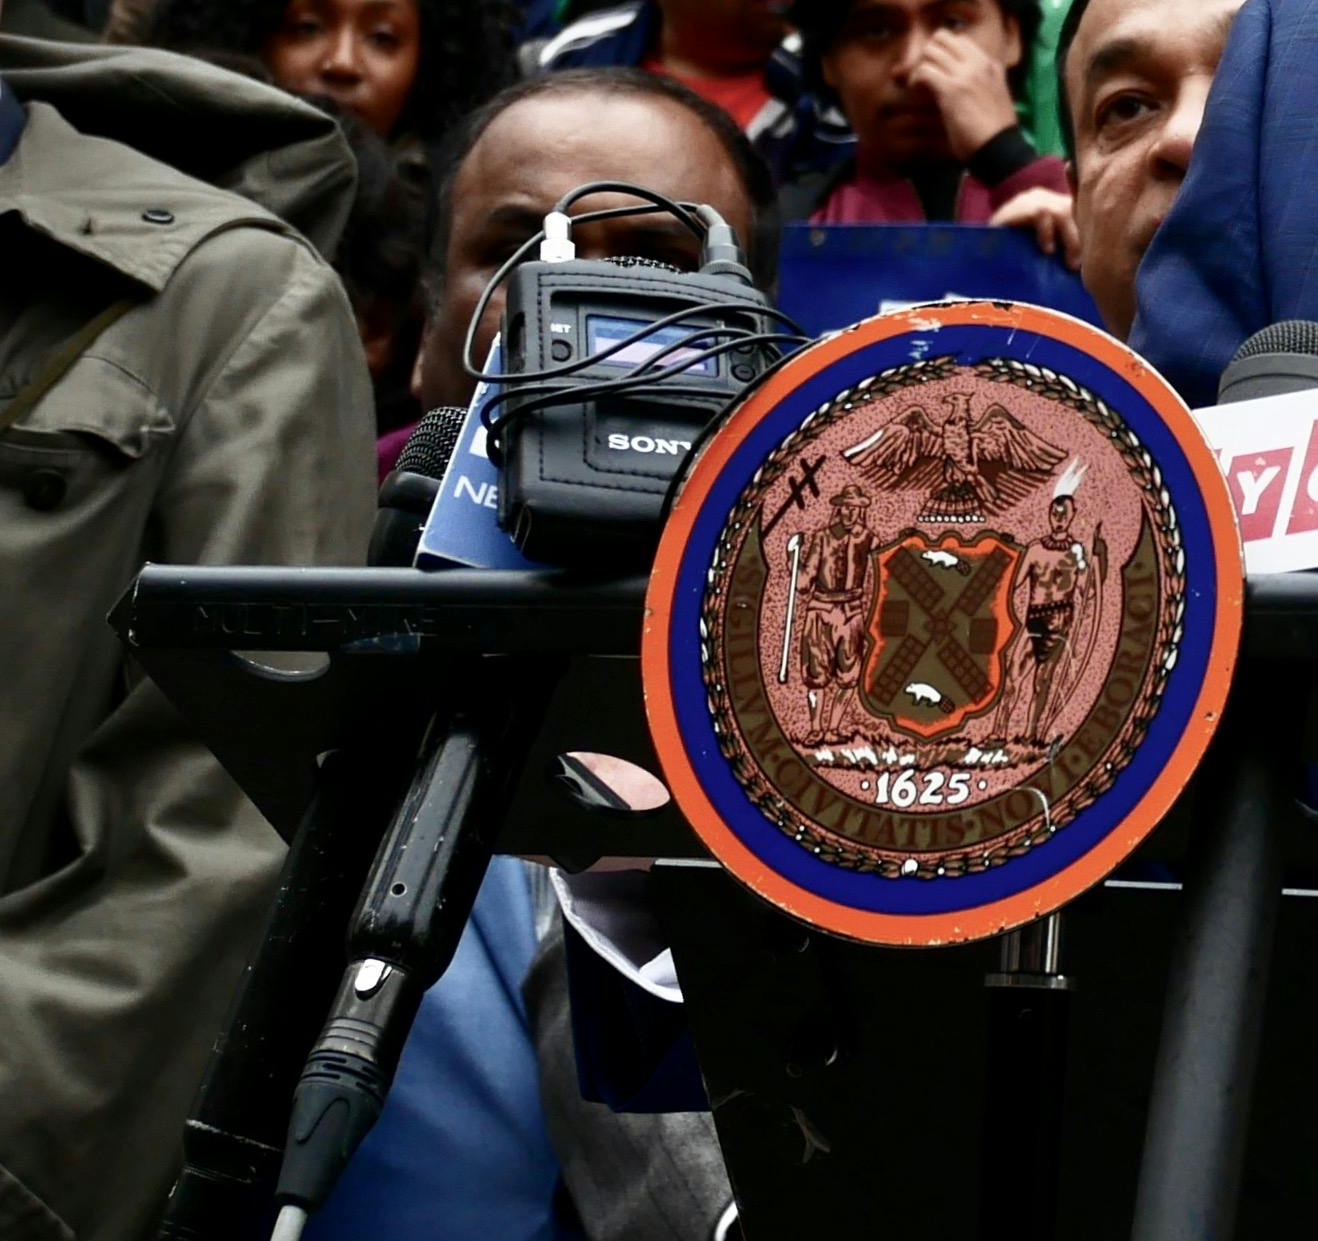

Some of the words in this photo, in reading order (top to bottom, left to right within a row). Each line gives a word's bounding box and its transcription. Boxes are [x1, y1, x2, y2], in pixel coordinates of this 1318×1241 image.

[608, 433, 692, 457] SON
[454, 475, 499, 509] NE
[875, 769, 972, 807] 1625
